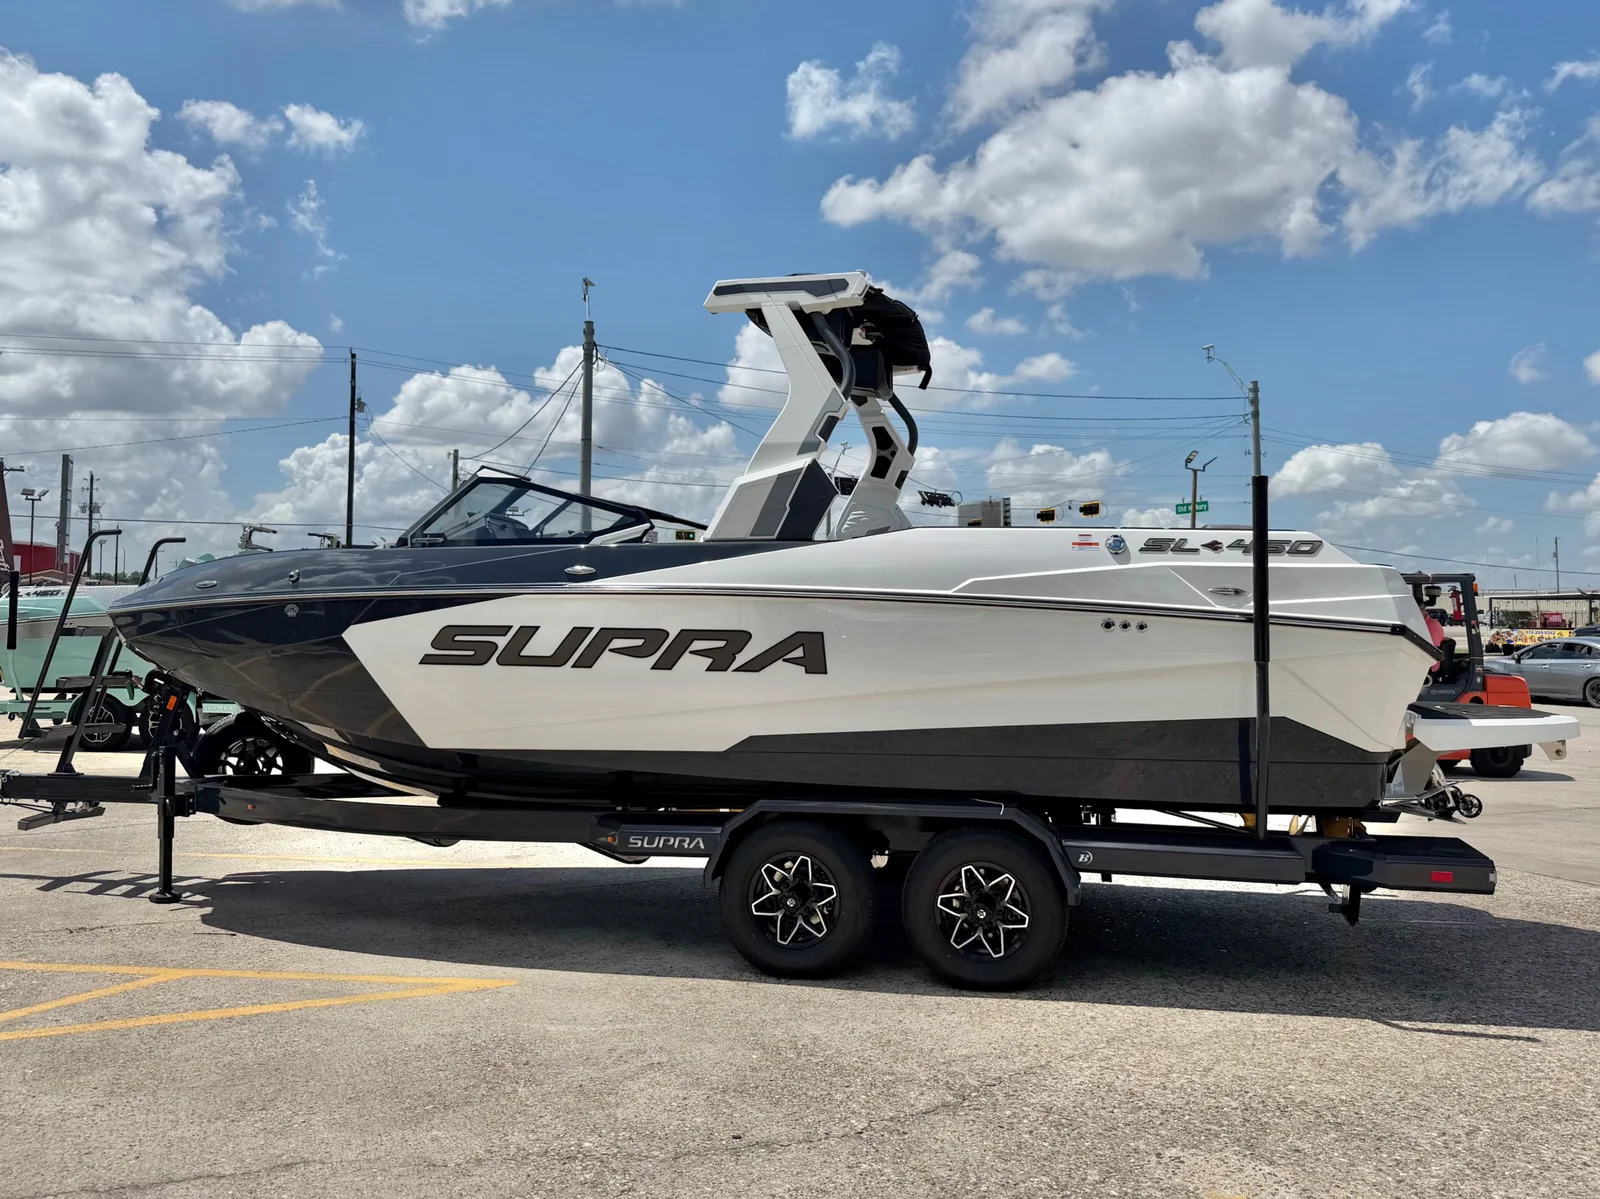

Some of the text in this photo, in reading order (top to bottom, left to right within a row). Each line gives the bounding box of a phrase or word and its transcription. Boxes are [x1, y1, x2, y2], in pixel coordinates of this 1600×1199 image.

[1177, 503, 1207, 513] Old Hkory
[1138, 538, 1200, 555] SL
[418, 624, 828, 675] SUPRA
[628, 835, 705, 849] SUPRA
